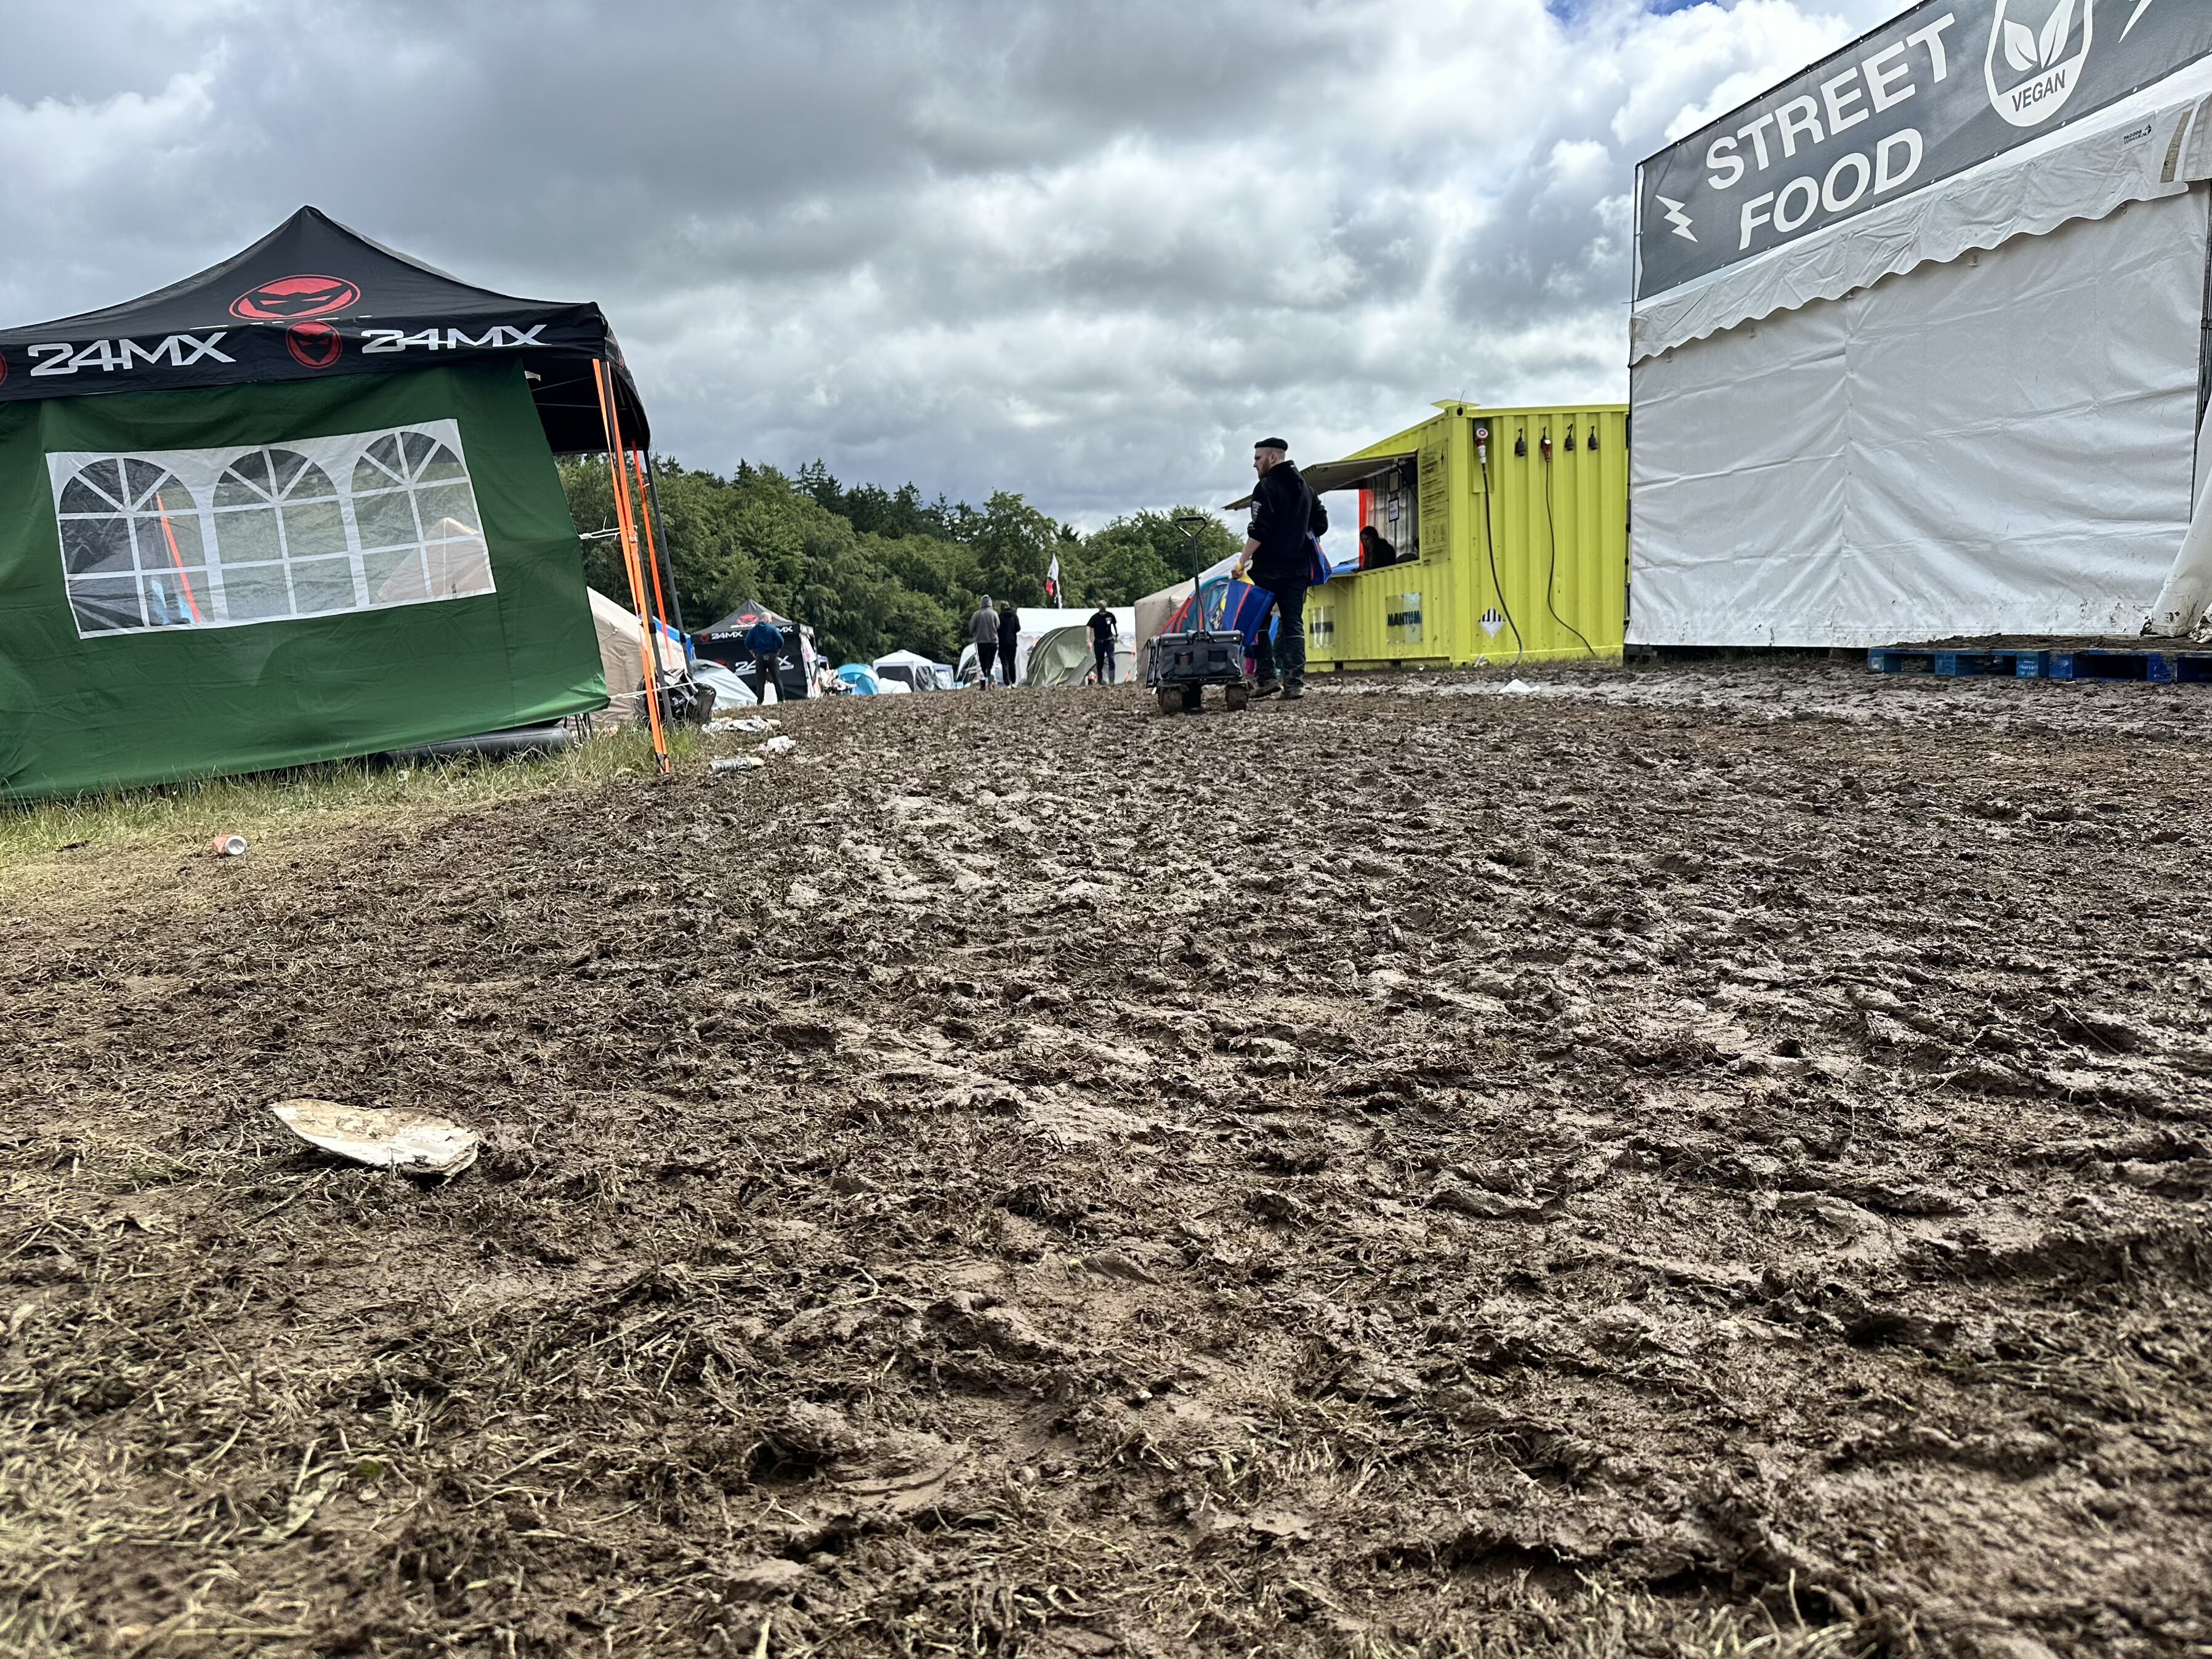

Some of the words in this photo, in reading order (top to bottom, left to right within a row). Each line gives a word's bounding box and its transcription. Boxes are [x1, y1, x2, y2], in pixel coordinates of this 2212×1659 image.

[1706, 12, 1955, 190] STREET
[2011, 69, 2065, 112] VEGAN
[1738, 128, 1923, 251] FOOD
[28, 331, 236, 377] 24MX
[361, 324, 552, 354] 24MX
[711, 631, 743, 640] 24MX
[1387, 610, 1421, 626] MANTUM
